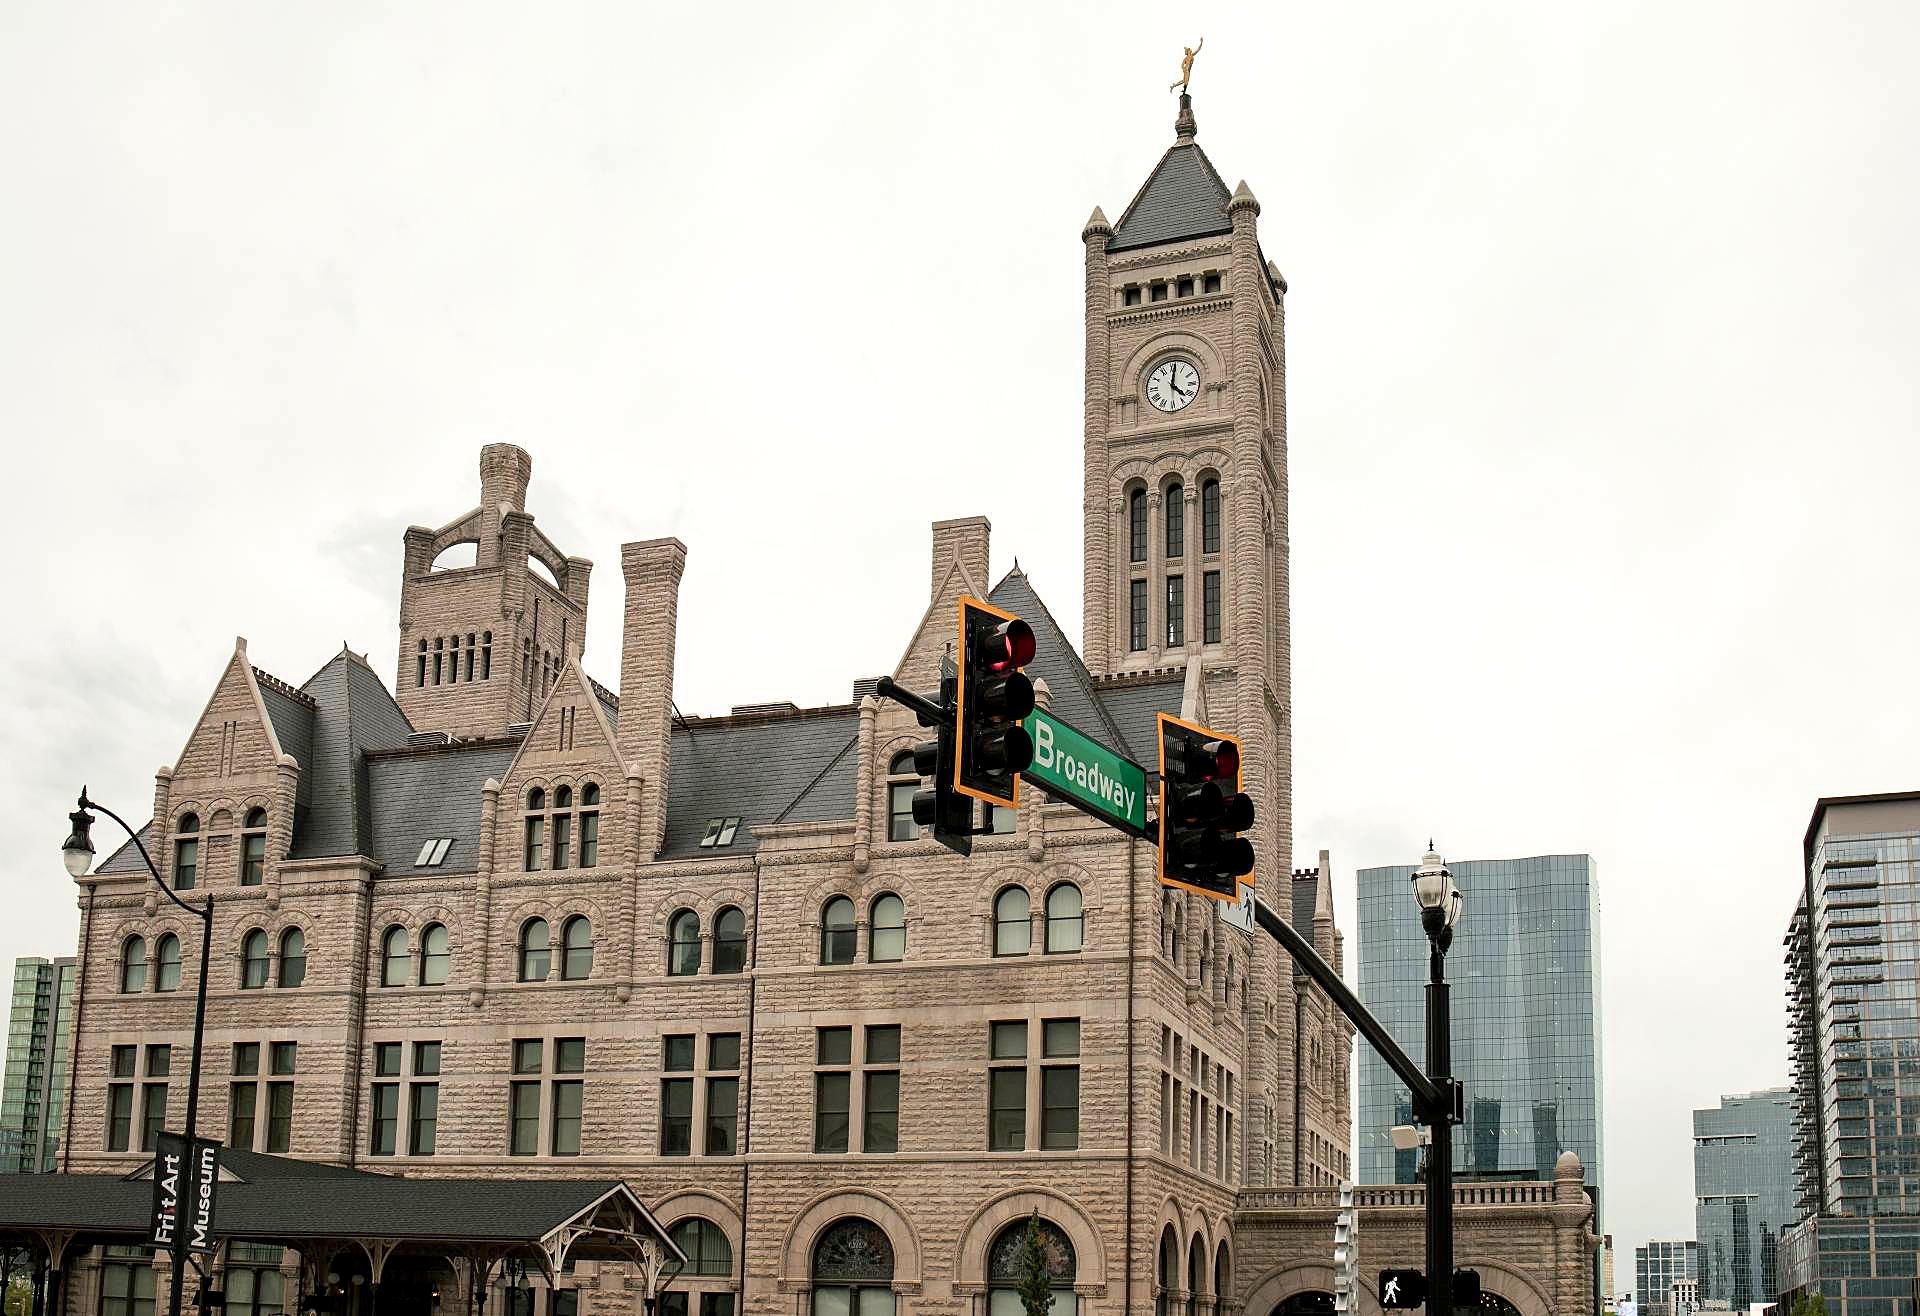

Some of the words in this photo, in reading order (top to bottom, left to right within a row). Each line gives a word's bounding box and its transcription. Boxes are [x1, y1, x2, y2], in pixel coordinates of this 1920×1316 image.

[1035, 718, 1136, 820] Broadway
[161, 1154, 180, 1198] Art
[191, 1147, 215, 1248] Museum
